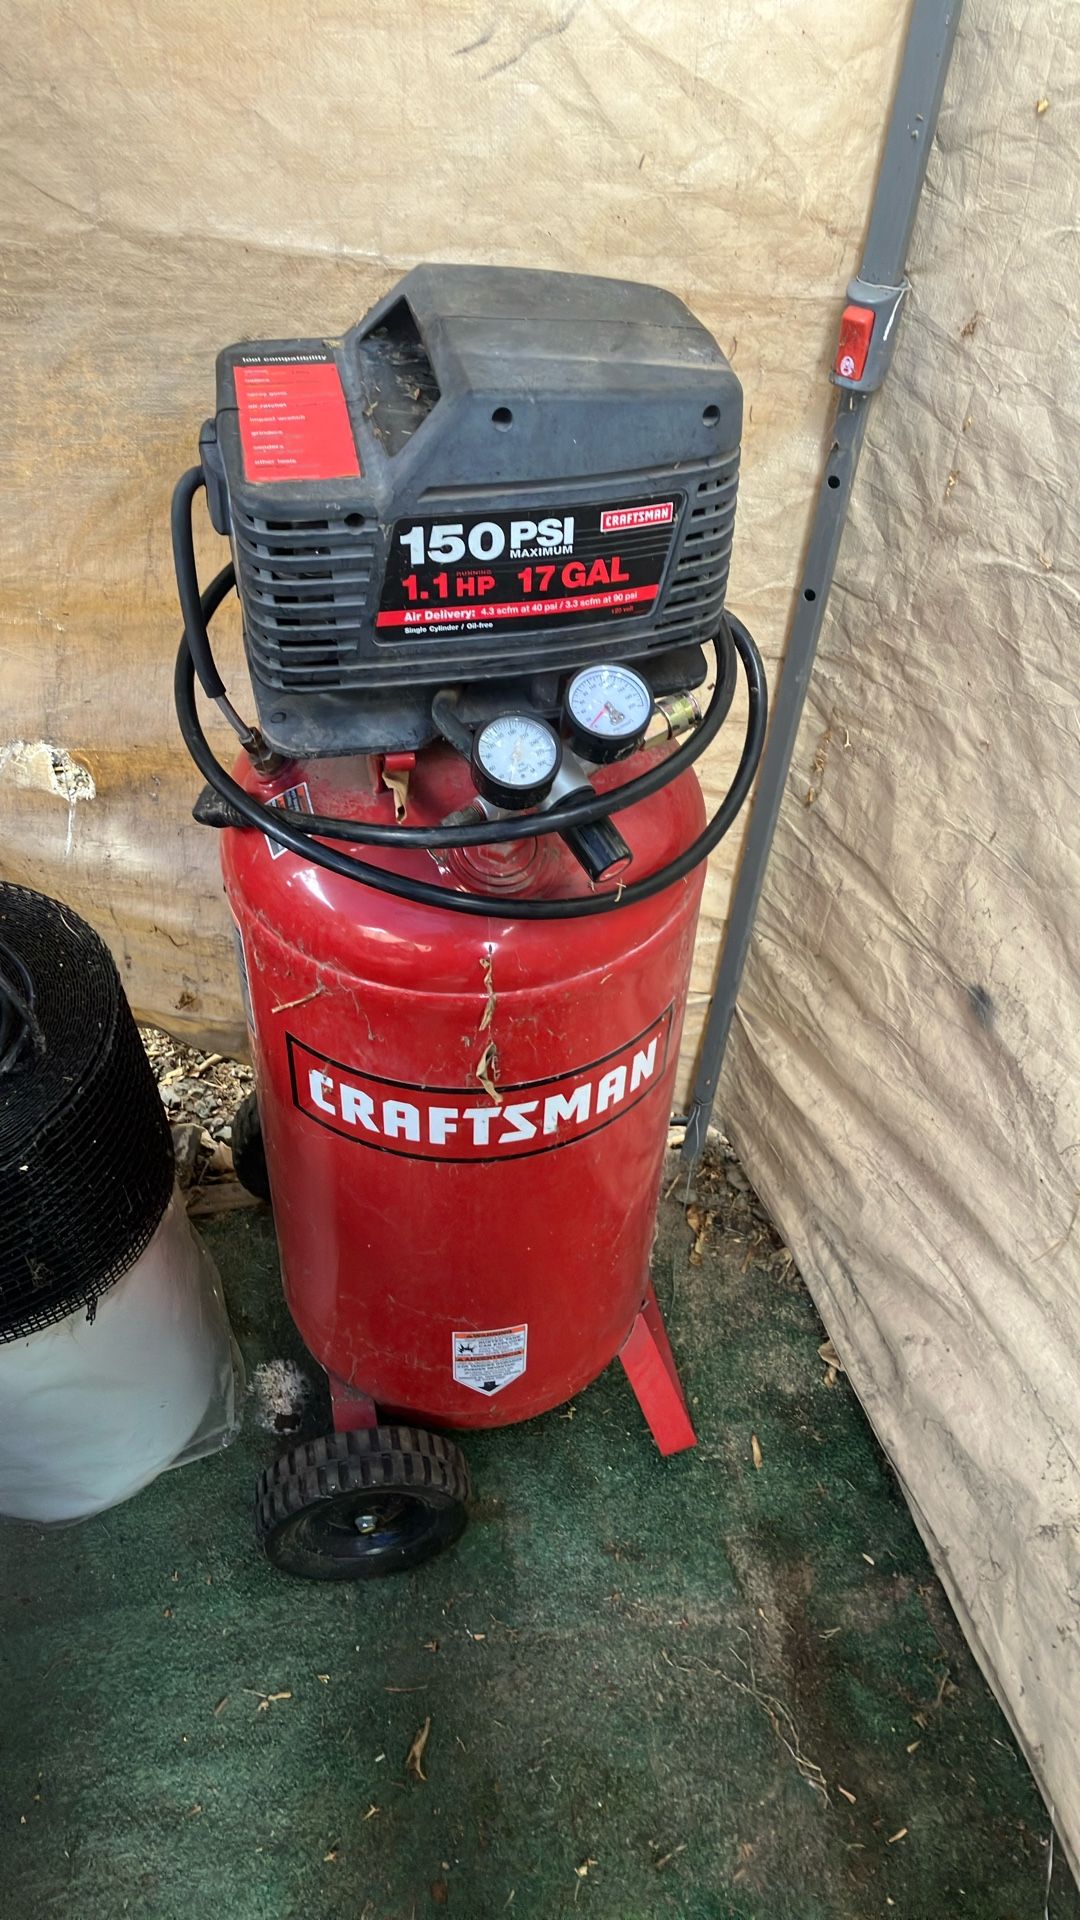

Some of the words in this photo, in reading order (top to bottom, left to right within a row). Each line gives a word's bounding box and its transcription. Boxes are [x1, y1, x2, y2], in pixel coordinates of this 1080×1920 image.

[605, 508, 669, 527] CRAFTSMAN
[400, 521, 506, 565] 150
[510, 516, 574, 548] PSI
[510, 545, 573, 559] MAXIMUM
[402, 572, 448, 600] 1.1
[456, 576, 496, 598] HP
[518, 565, 556, 593] 17
[561, 556, 630, 588] GAL
[404, 612, 421, 622] Air
[424, 609, 475, 621] Delivery:
[481, 607, 494, 616] 4.3
[497, 605, 519, 614] scfm
[521, 604, 530, 613] at
[544, 601, 558, 613] psi
[565, 600, 578, 609] 3.3
[580, 596, 600, 606] scfm
[603, 595, 612, 604] at
[624, 592, 638, 604] psi
[404, 626, 427, 634] Single
[429, 624, 459, 633] Cylinder
[466, 622, 494, 630] Oil-free
[308, 1037, 659, 1146] CRAFTSMAN
